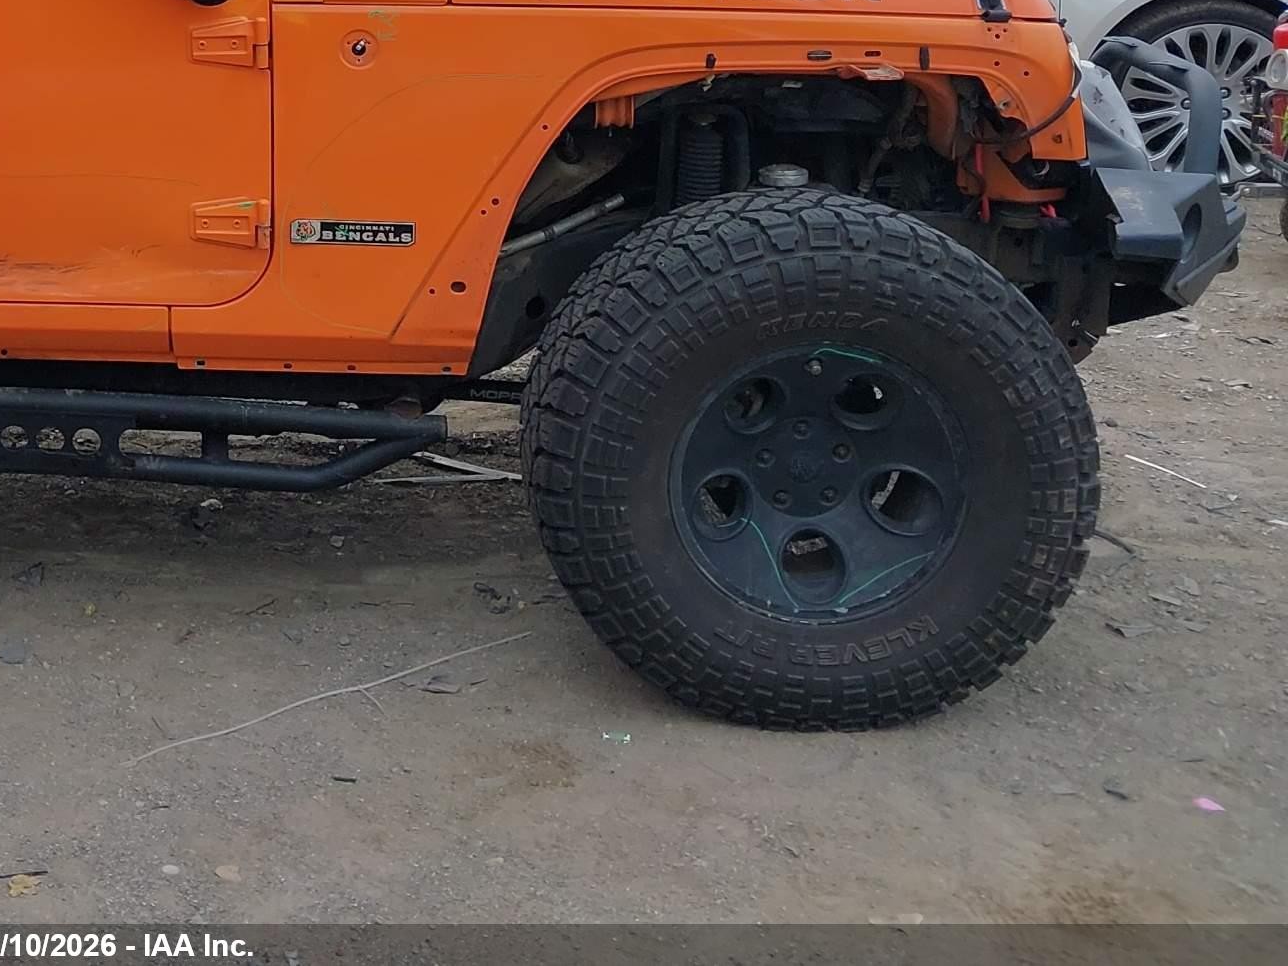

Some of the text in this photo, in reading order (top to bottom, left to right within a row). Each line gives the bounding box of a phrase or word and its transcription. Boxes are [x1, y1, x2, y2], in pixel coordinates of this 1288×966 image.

[321, 230, 412, 243] BENGALS
[470, 389, 521, 401] MOPA
[788, 614, 940, 666] KLEVER
